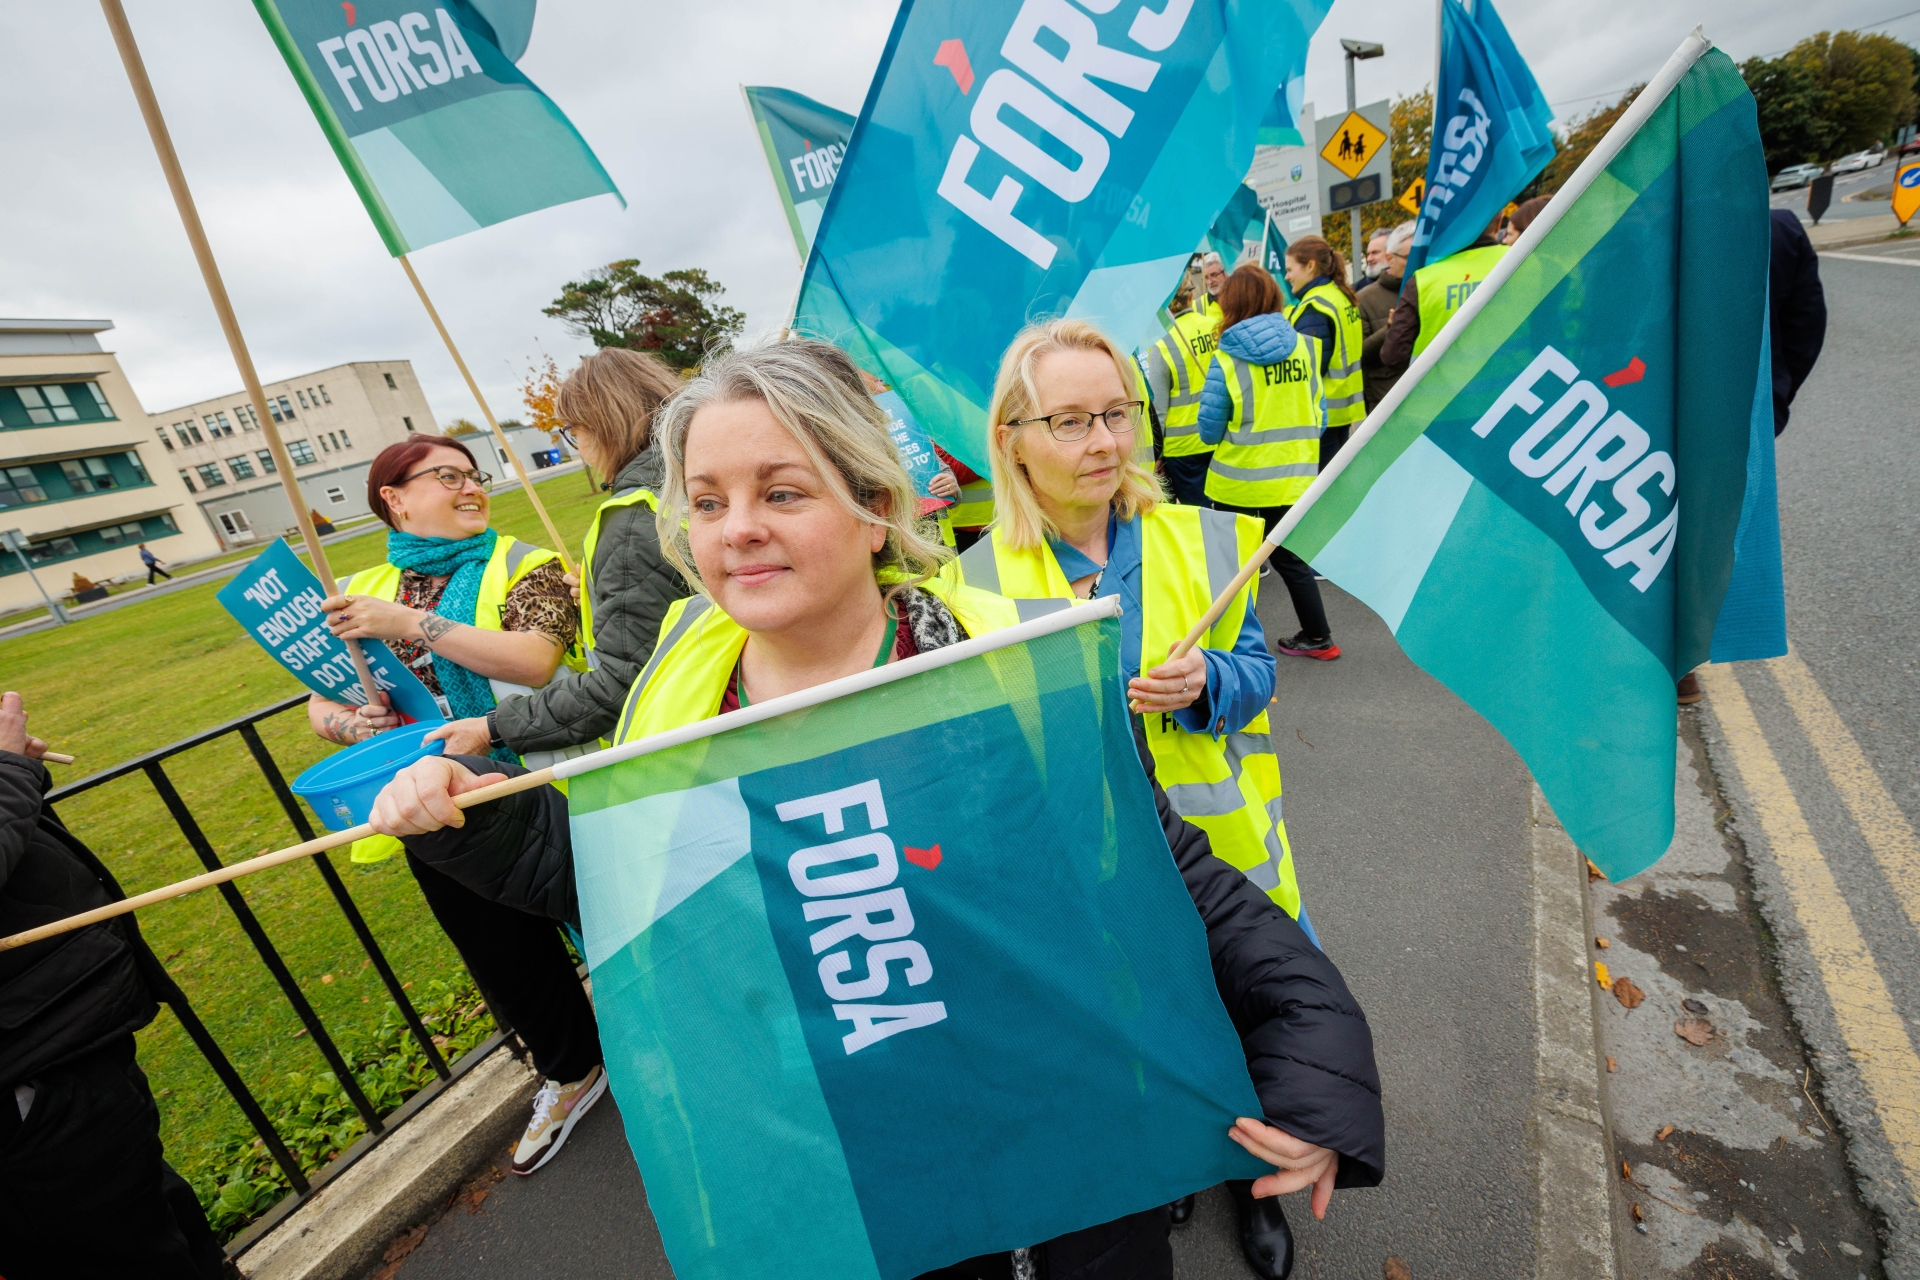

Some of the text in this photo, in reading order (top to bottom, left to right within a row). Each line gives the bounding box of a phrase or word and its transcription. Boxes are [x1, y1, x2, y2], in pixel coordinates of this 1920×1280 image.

[317, 2, 483, 112] FÓRSA
[790, 139, 847, 193] FÓRS
[1259, 196, 1274, 204] ke's
[1272, 194, 1307, 209] Hospital
[1275, 203, 1310, 217] Kilkenny
[1446, 274, 1483, 310] FÓ
[1471, 345, 1678, 593] FÓRSA
[256, 587, 323, 647] ENOUGH
[280, 623, 332, 671] STAFF
[311, 663, 345, 689] DO
[775, 779, 947, 1055] FÓRSA
